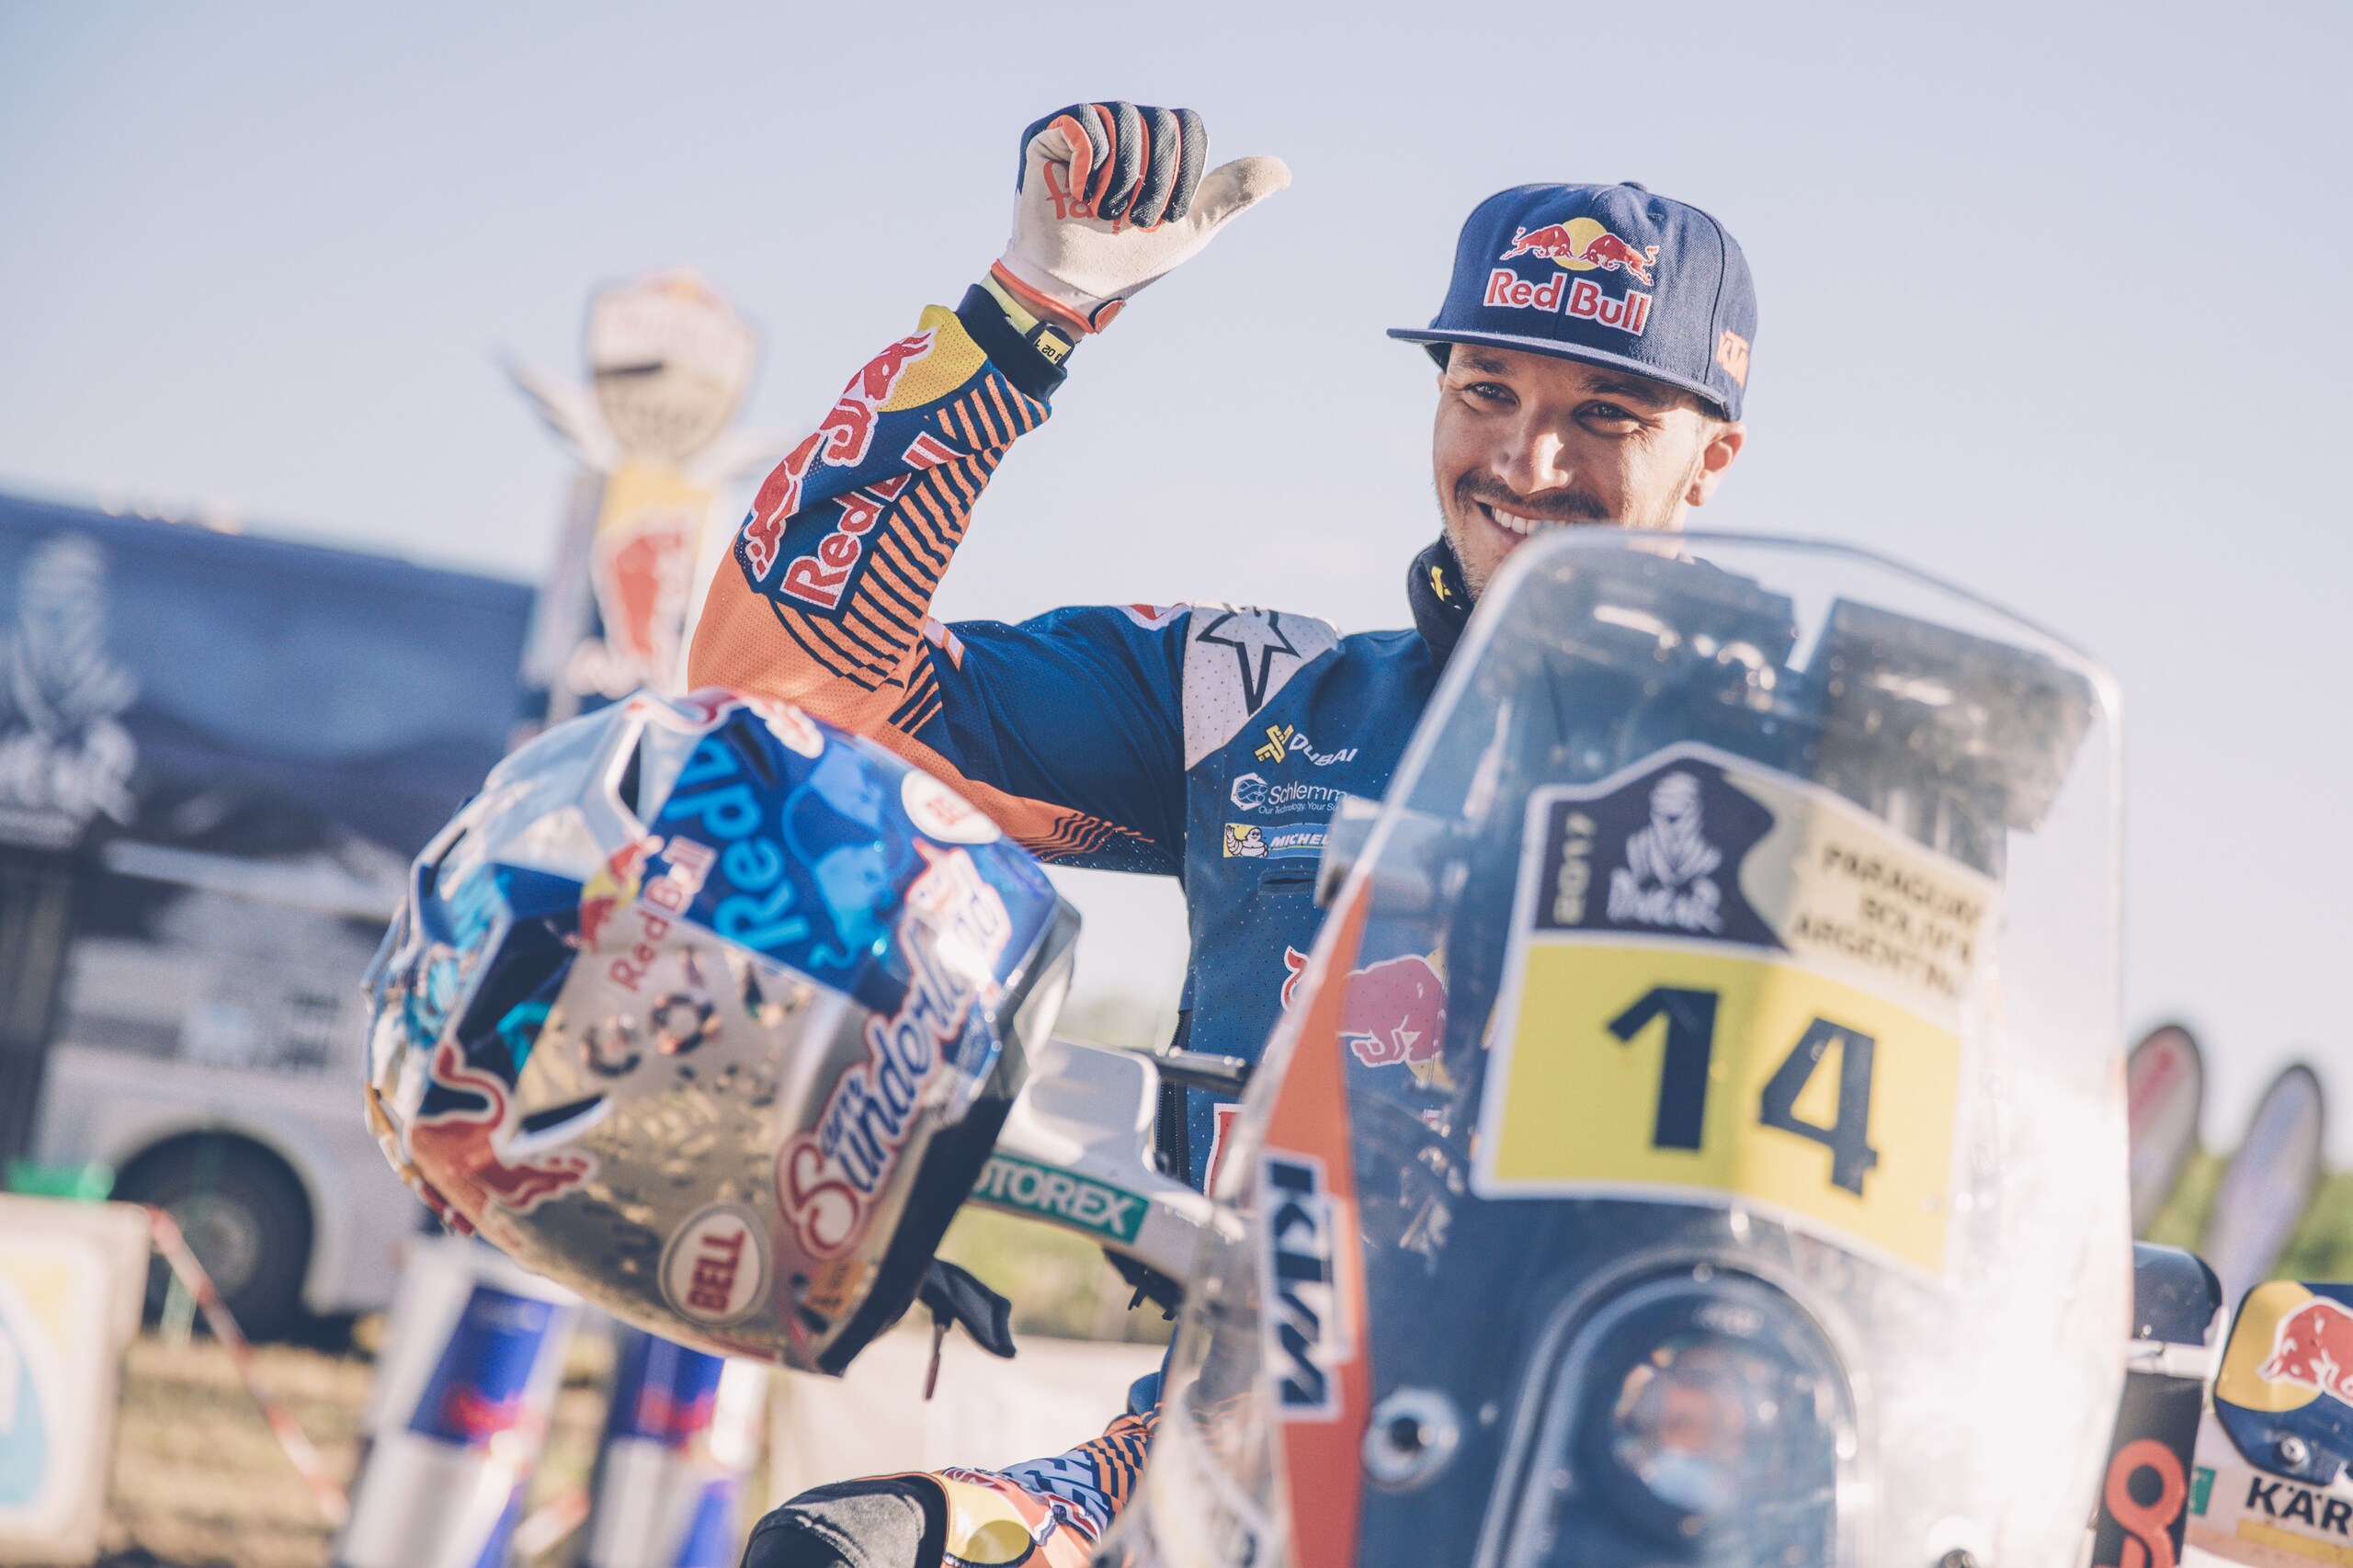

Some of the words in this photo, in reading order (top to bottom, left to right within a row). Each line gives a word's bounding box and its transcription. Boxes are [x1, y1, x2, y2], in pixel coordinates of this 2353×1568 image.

[1483, 267, 1568, 313] Red
[1565, 278, 1653, 336] Bull
[1716, 329, 1749, 389] KTM
[779, 491, 886, 610] Red
[1289, 733, 1358, 766] DUBAI
[1258, 805, 1273, 815] Our
[1307, 801, 1325, 811] Your
[1267, 780, 1360, 805] Schlemm
[609, 905, 671, 993] Red
[645, 836, 717, 914] Bll
[1794, 914, 1960, 999] ARGENTIN
[790, 862, 1002, 1251] Sunderlnd
[1605, 983, 1879, 1199] 14
[686, 1229, 746, 1314] BELL
[1267, 1160, 1336, 1406] KTM
